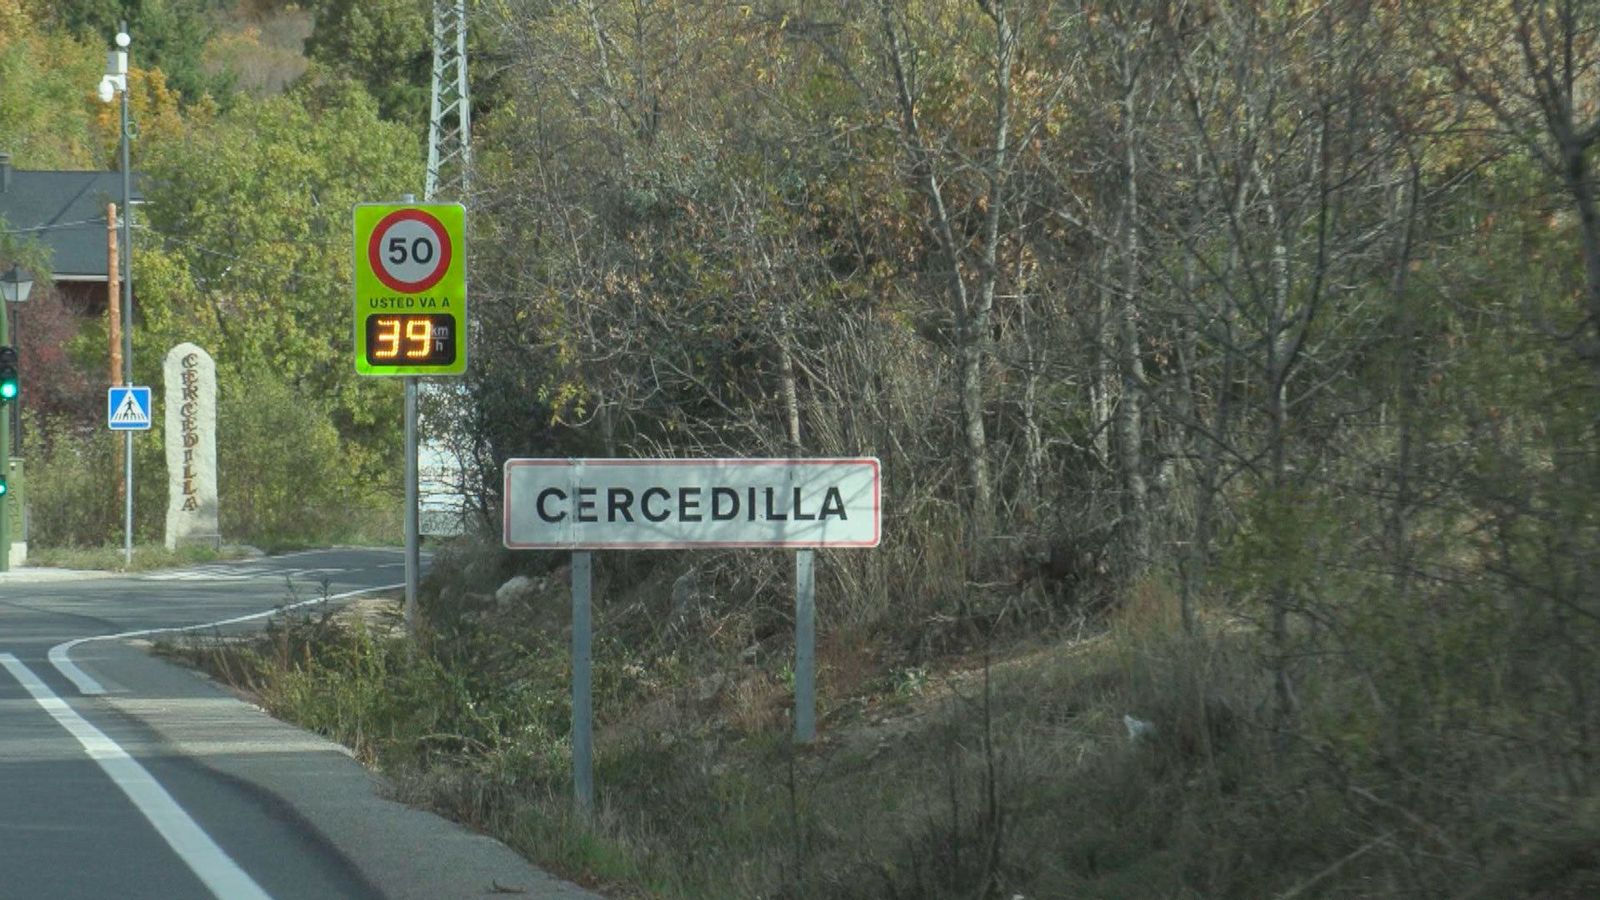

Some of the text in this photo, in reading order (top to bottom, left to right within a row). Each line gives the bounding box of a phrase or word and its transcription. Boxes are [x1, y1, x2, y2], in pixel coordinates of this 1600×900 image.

[388, 237, 434, 265] 50
[369, 296, 450, 309] USTED VA A
[375, 319, 432, 358] 39
[180, 353, 199, 512] CERCEDILLA
[536, 486, 848, 523] CERCEDILLA
